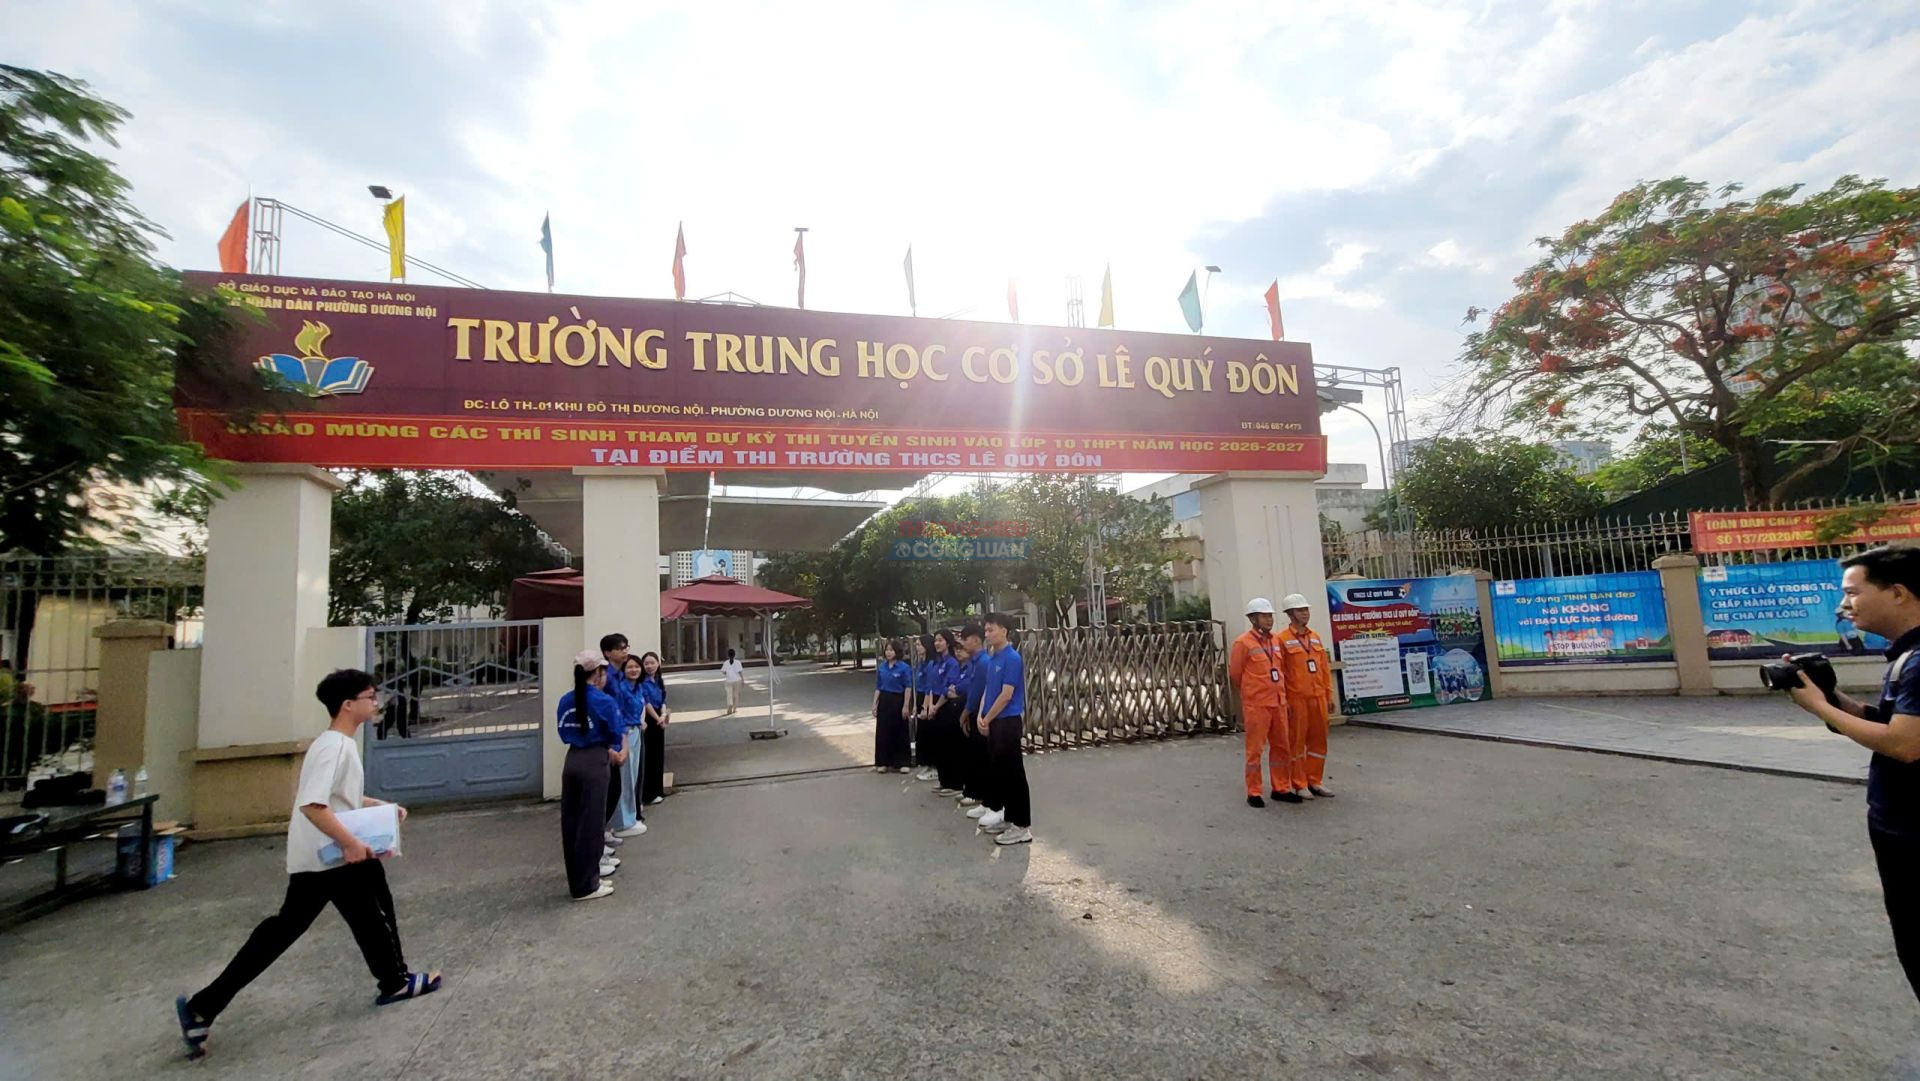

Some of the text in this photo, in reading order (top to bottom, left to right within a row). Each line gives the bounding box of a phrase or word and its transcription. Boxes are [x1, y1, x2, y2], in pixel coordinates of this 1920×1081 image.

[240, 282, 270, 293] GIÁO
[273, 285, 298, 296] DỤC
[302, 286, 317, 296] VÀ
[321, 287, 347, 298] ĐÀO
[351, 290, 374, 301] TẠO
[378, 290, 393, 300] HÀ
[396, 292, 415, 302] NỘI
[286, 298, 313, 311] DÂN
[316, 299, 367, 314] PHƯỜNG
[371, 303, 412, 316] DƯƠNG
[416, 305, 437, 319] NỘI
[447, 306, 1299, 398] TRƯỜNG TRUNG HỌC CƠ SỞ LÊ QUÝ ĐÔN
[491, 398, 509, 410] LÔ
[554, 402, 583, 411] KHU
[587, 401, 606, 412] ĐÔ
[611, 404, 630, 415] THỊ
[633, 404, 680, 415] DƯƠNG
[683, 403, 704, 416] NỘI
[711, 406, 765, 417] PHƯỜNG
[768, 408, 813, 419] DƯƠNG
[816, 408, 836, 420] NỘI
[842, 408, 857, 419] HÀ
[860, 409, 879, 421] NỘI
[326, 422, 419, 438] MỪNG
[429, 424, 488, 439] CÁC
[498, 427, 541, 440] THÍ
[551, 429, 616, 441] SINH
[624, 431, 696, 442] THAM
[705, 432, 741, 446] DỰ
[784, 434, 820, 445] THI
[828, 431, 898, 446] TUYỂN
[906, 436, 956, 446] SINH
[963, 436, 1002, 448] VÀO
[1054, 440, 1075, 449] 10
[1083, 440, 1125, 449] THPT
[1133, 439, 1174, 450] NĂM
[1180, 441, 1214, 453] HỌC
[1220, 442, 1304, 452] 2026-2027
[591, 445, 1102, 467] TẠI ĐIỂM THI TRƯỜNG THCS LÊ QUÝ ĐÔN
[1706, 519, 1736, 530] TOÀN
[1717, 533, 1732, 545] SỐ
[1777, 583, 1817, 593] TRONG
[1562, 602, 1610, 614] KHÔNG
[1743, 598, 1776, 607] HÀNH
[1535, 616, 1557, 627] BẠO
[1732, 611, 1755, 620] CHA
[1757, 611, 1774, 619] AN
